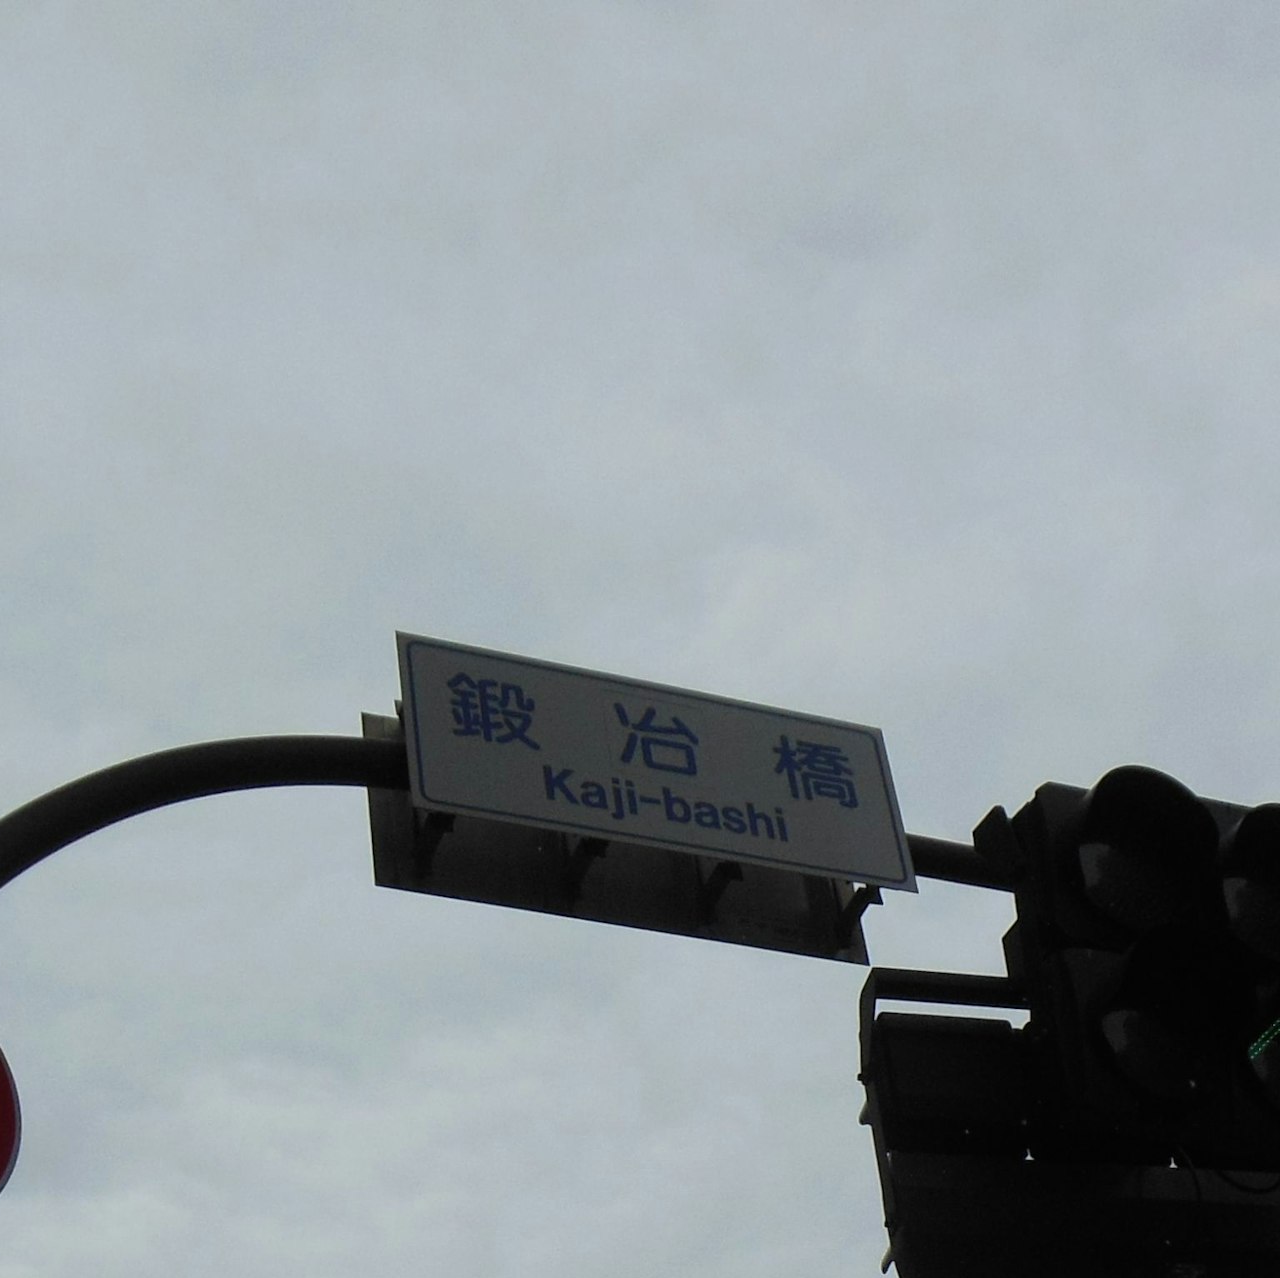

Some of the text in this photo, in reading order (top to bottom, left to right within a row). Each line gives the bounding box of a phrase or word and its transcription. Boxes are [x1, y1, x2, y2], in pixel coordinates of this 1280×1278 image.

[447, 673, 859, 809] 鍛冶橋
[544, 764, 790, 842] Kaji-bashi
